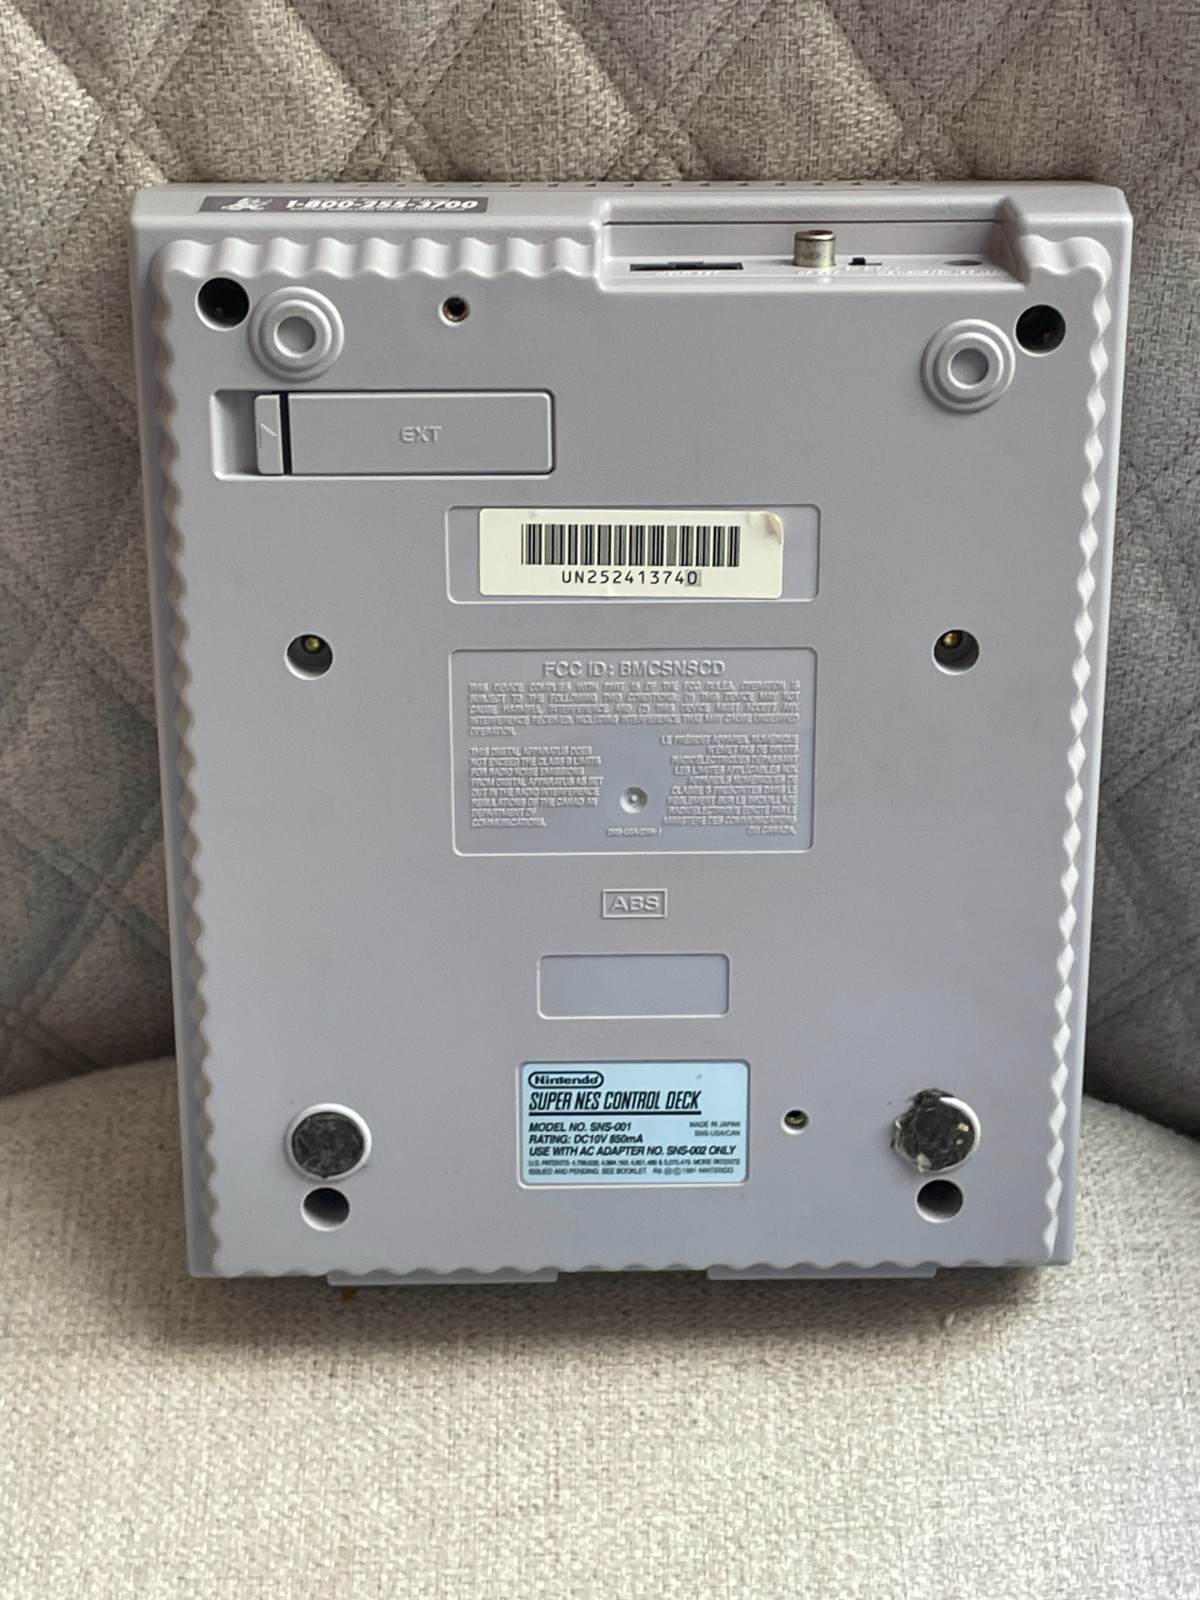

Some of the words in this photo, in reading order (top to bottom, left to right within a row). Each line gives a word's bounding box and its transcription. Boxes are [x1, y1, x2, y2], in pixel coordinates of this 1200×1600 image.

[286, 199, 479, 210] 1-800-255-3700
[402, 426, 442, 441] EXT
[561, 570, 698, 585] UN252413740
[544, 660, 582, 677] FCC
[588, 660, 614, 677] ID:
[620, 660, 726, 677] BMCSNSCD
[612, 895, 660, 911] ABS
[534, 1075, 600, 1085] Nintendo
[528, 1091, 573, 1111] SUPER
[574, 1091, 602, 1111] NES
[603, 1090, 661, 1110] CONTROL
[665, 1090, 702, 1110] DECK
[528, 1122, 566, 1132] MODEL
[568, 1122, 588, 1132] NO.
[590, 1121, 632, 1132] SNS-001
[689, 1120, 709, 1128] MADE
[528, 1134, 572, 1145] RATING:
[573, 1134, 608, 1145] DC10V
[609, 1133, 643, 1144] 850mA
[529, 1146, 550, 1157] USE
[552, 1146, 578, 1156] WITH
[579, 1146, 595, 1156] AC
[596, 1146, 645, 1156] ADAPTER
[646, 1145, 664, 1156] NO.
[666, 1145, 708, 1156] SNS-002
[709, 1144, 737, 1155] ONLY
